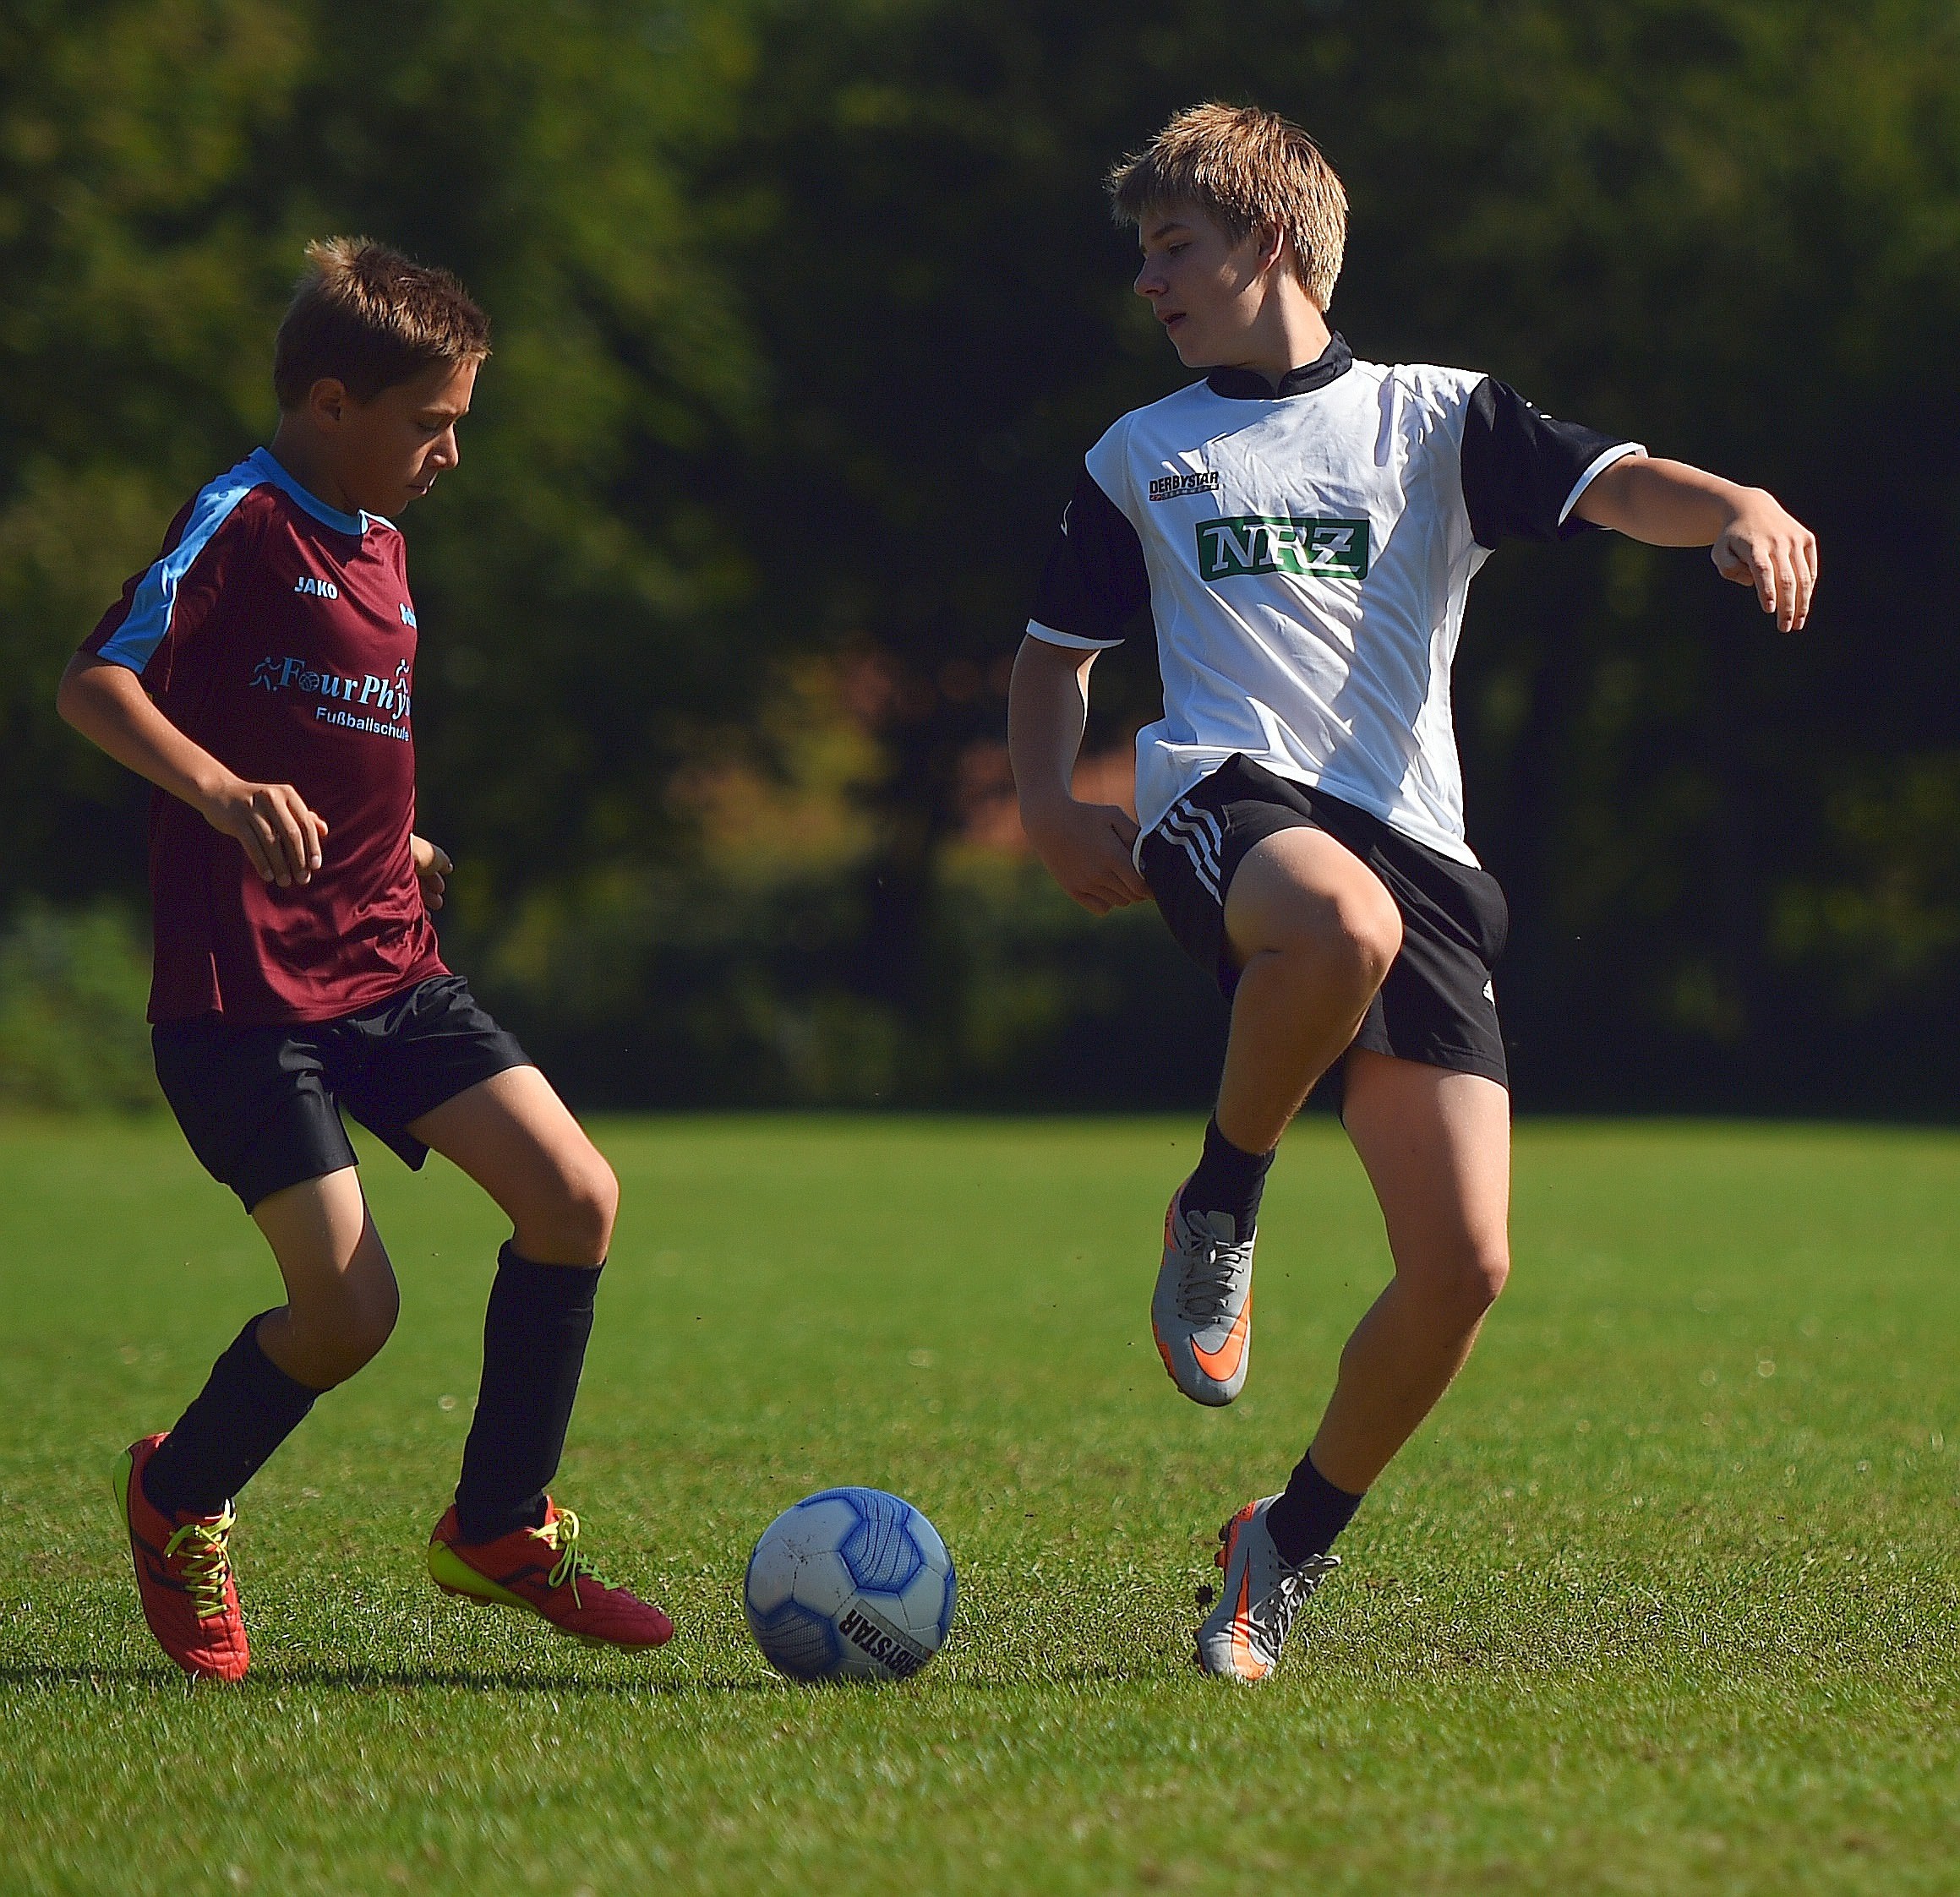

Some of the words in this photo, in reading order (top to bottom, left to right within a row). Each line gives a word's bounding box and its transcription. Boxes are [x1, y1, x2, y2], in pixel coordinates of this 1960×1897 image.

[1149, 471, 1219, 494] DERBYSTAR
[1203, 523, 1361, 573] NRZ
[294, 576, 338, 600] JAKO
